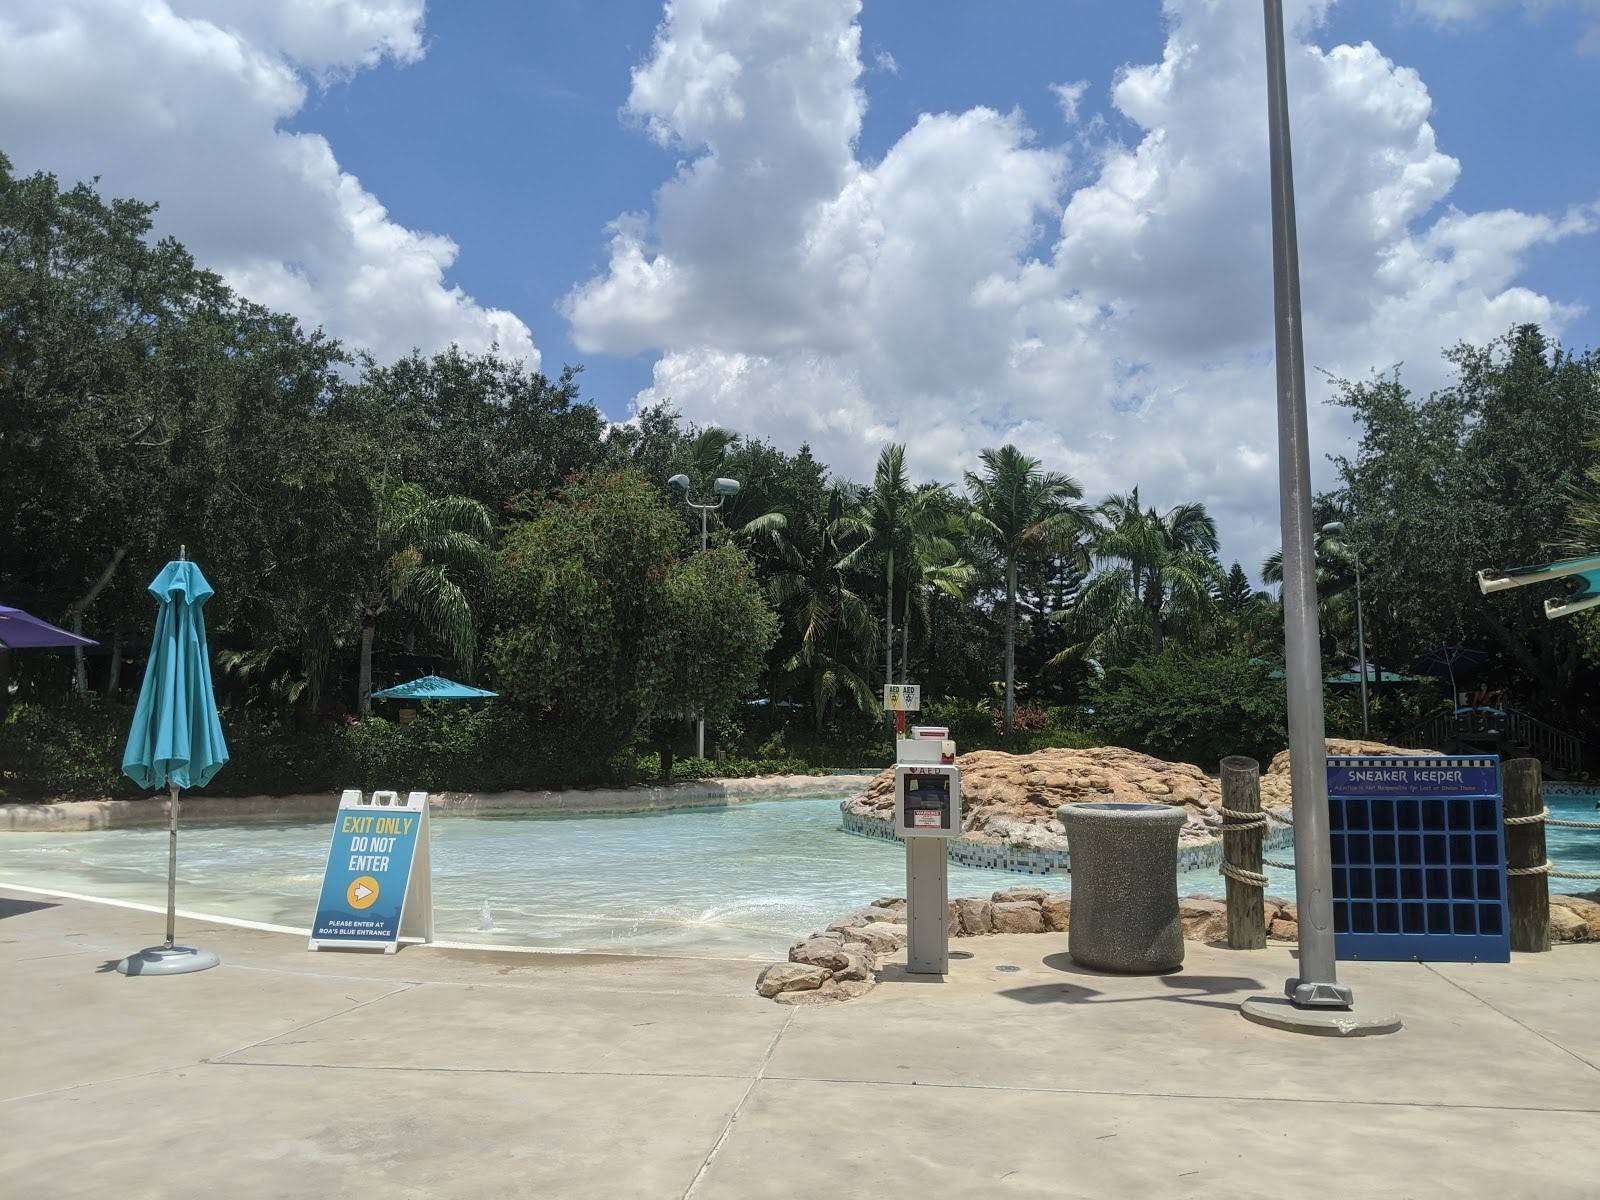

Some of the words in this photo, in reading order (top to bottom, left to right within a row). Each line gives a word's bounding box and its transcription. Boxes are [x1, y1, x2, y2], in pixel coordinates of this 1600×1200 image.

[903, 686, 915, 694] AED
[1348, 770, 1408, 784] SNEAKER
[1413, 770, 1464, 785] KEEPER
[342, 816, 375, 834] EXIT
[376, 817, 413, 835] ONLY
[350, 836, 368, 852] DO
[370, 837, 396, 853] NOT
[348, 855, 390, 872] ENTER
